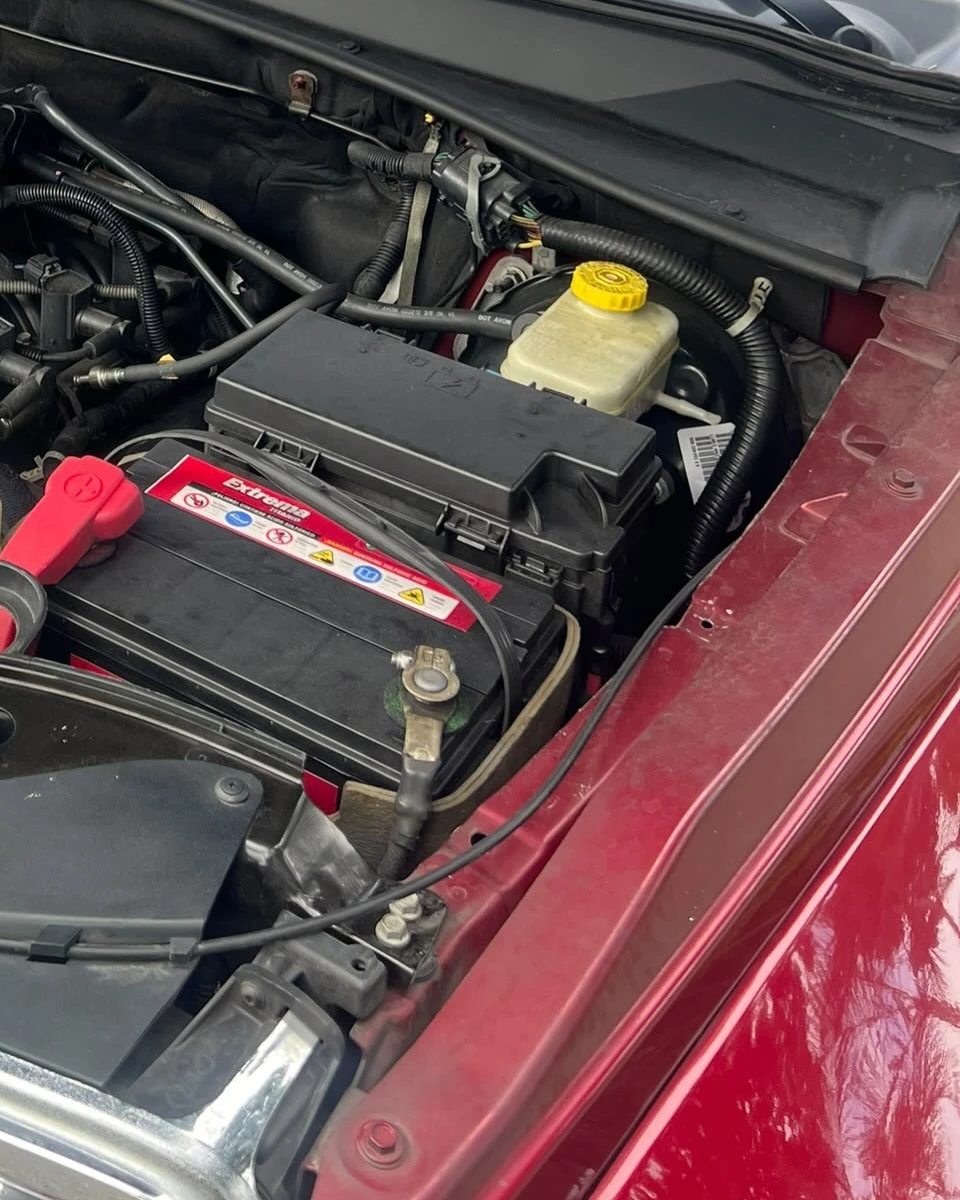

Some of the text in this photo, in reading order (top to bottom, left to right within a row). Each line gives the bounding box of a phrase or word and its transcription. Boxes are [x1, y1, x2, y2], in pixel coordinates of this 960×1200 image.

[477, 314, 512, 326] DOT AVON
[222, 477, 311, 519] Extrema
